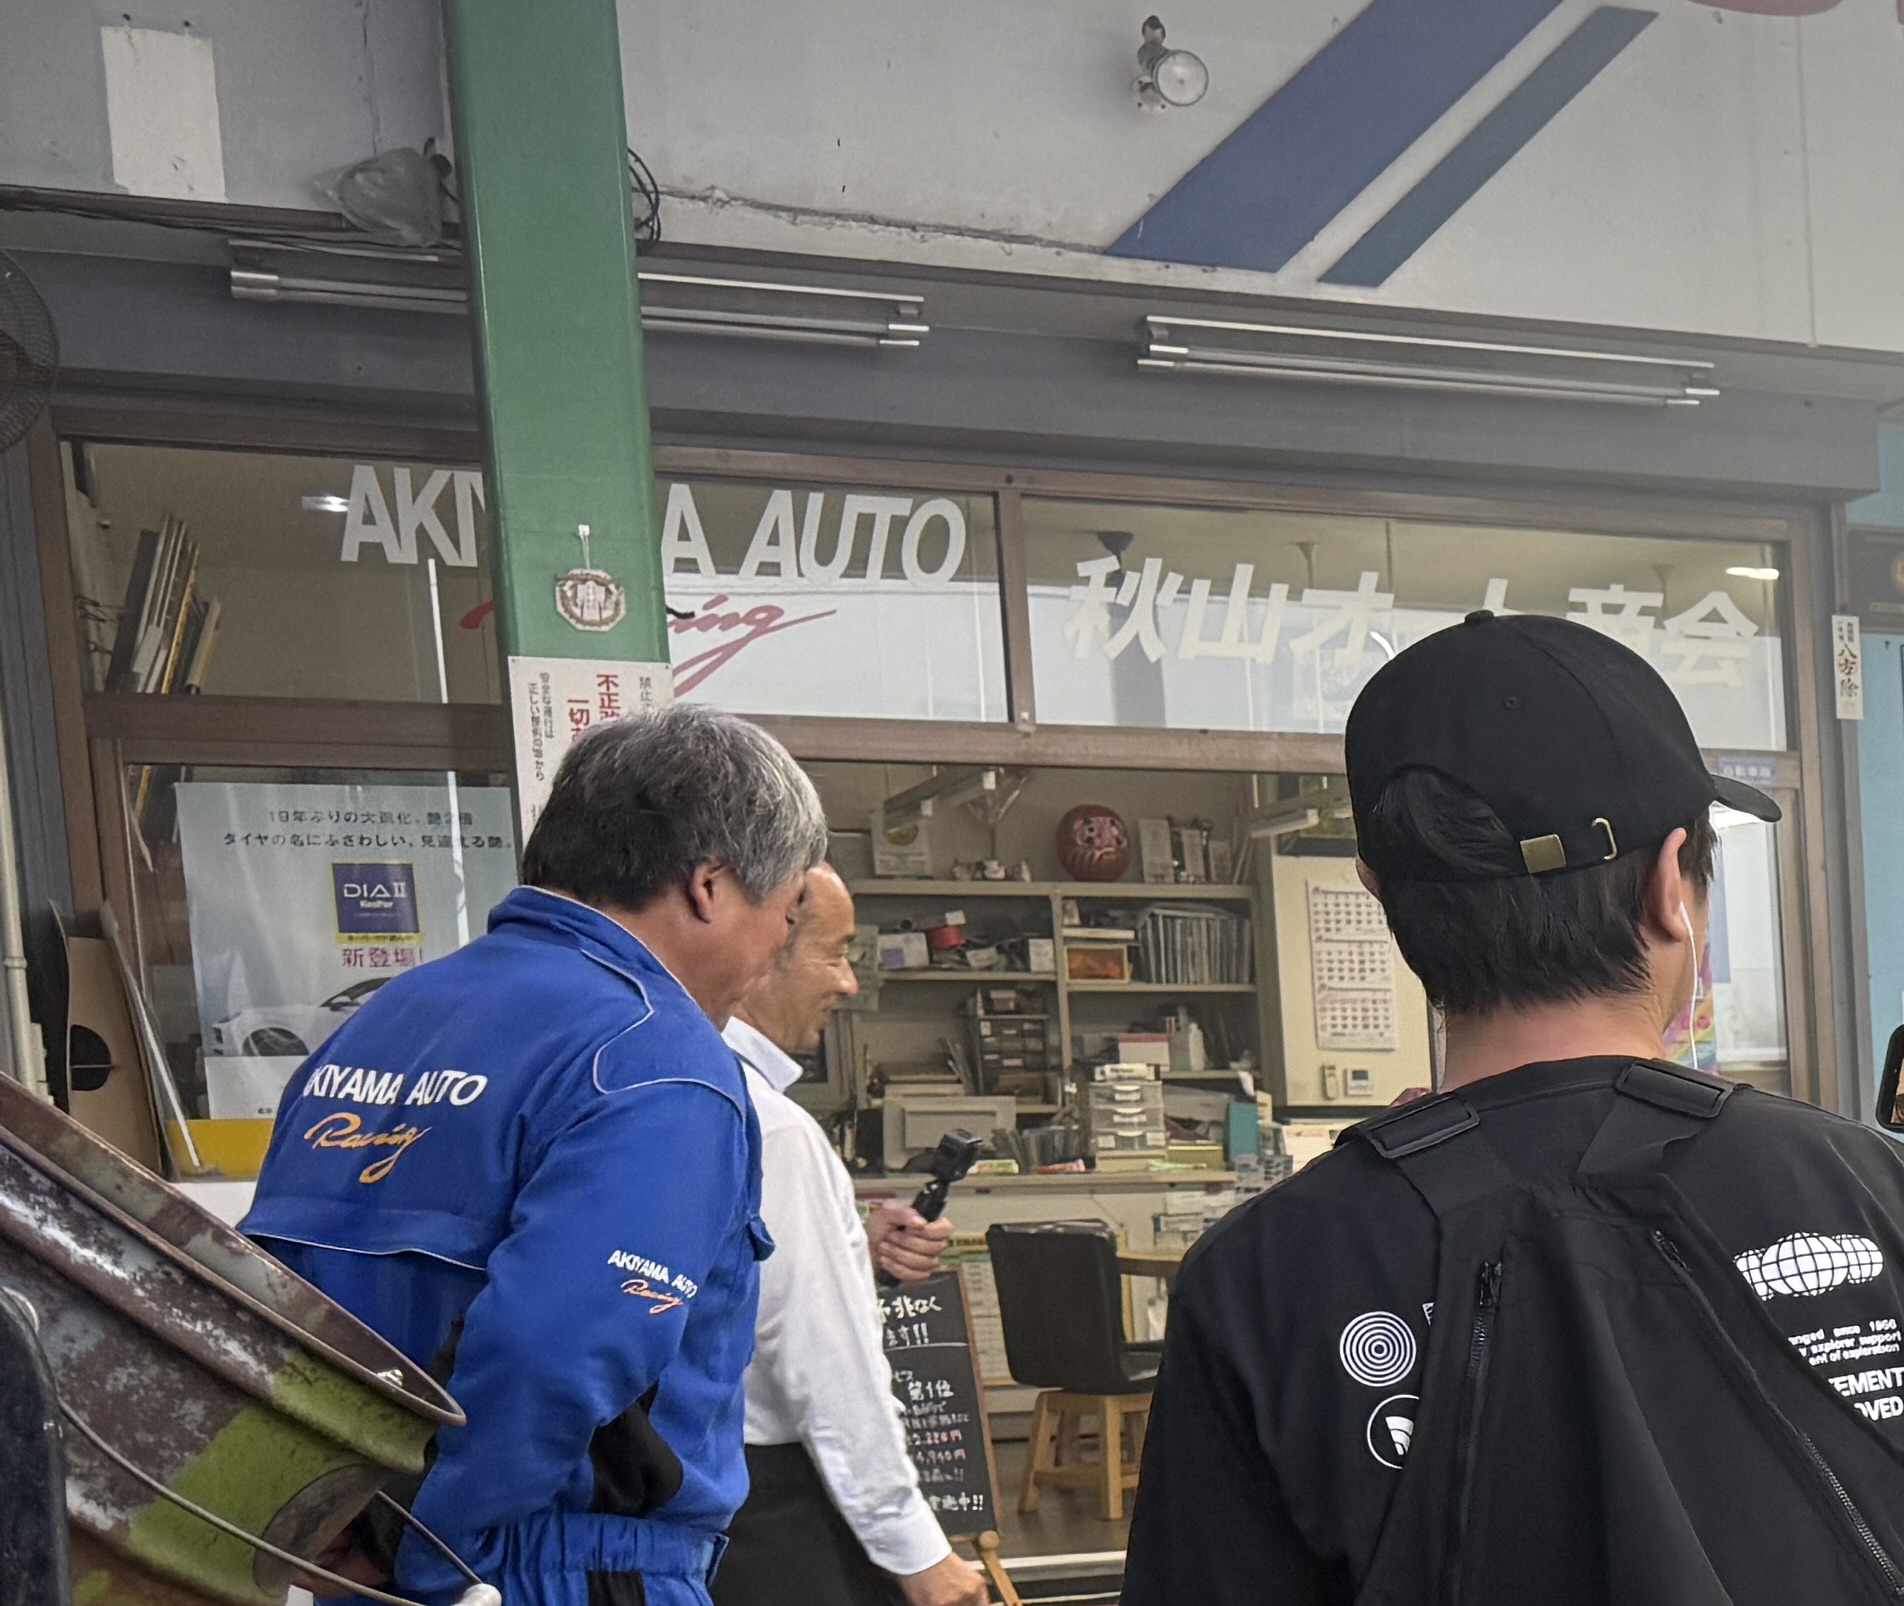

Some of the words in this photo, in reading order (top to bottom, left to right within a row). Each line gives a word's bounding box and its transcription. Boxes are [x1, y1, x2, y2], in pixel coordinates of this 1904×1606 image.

[340, 465, 717, 578] AKIA
[739, 489, 967, 588] AUTO
[405, 1070, 489, 1106] AUTO
[607, 1250, 669, 1285] AKIYAMA
